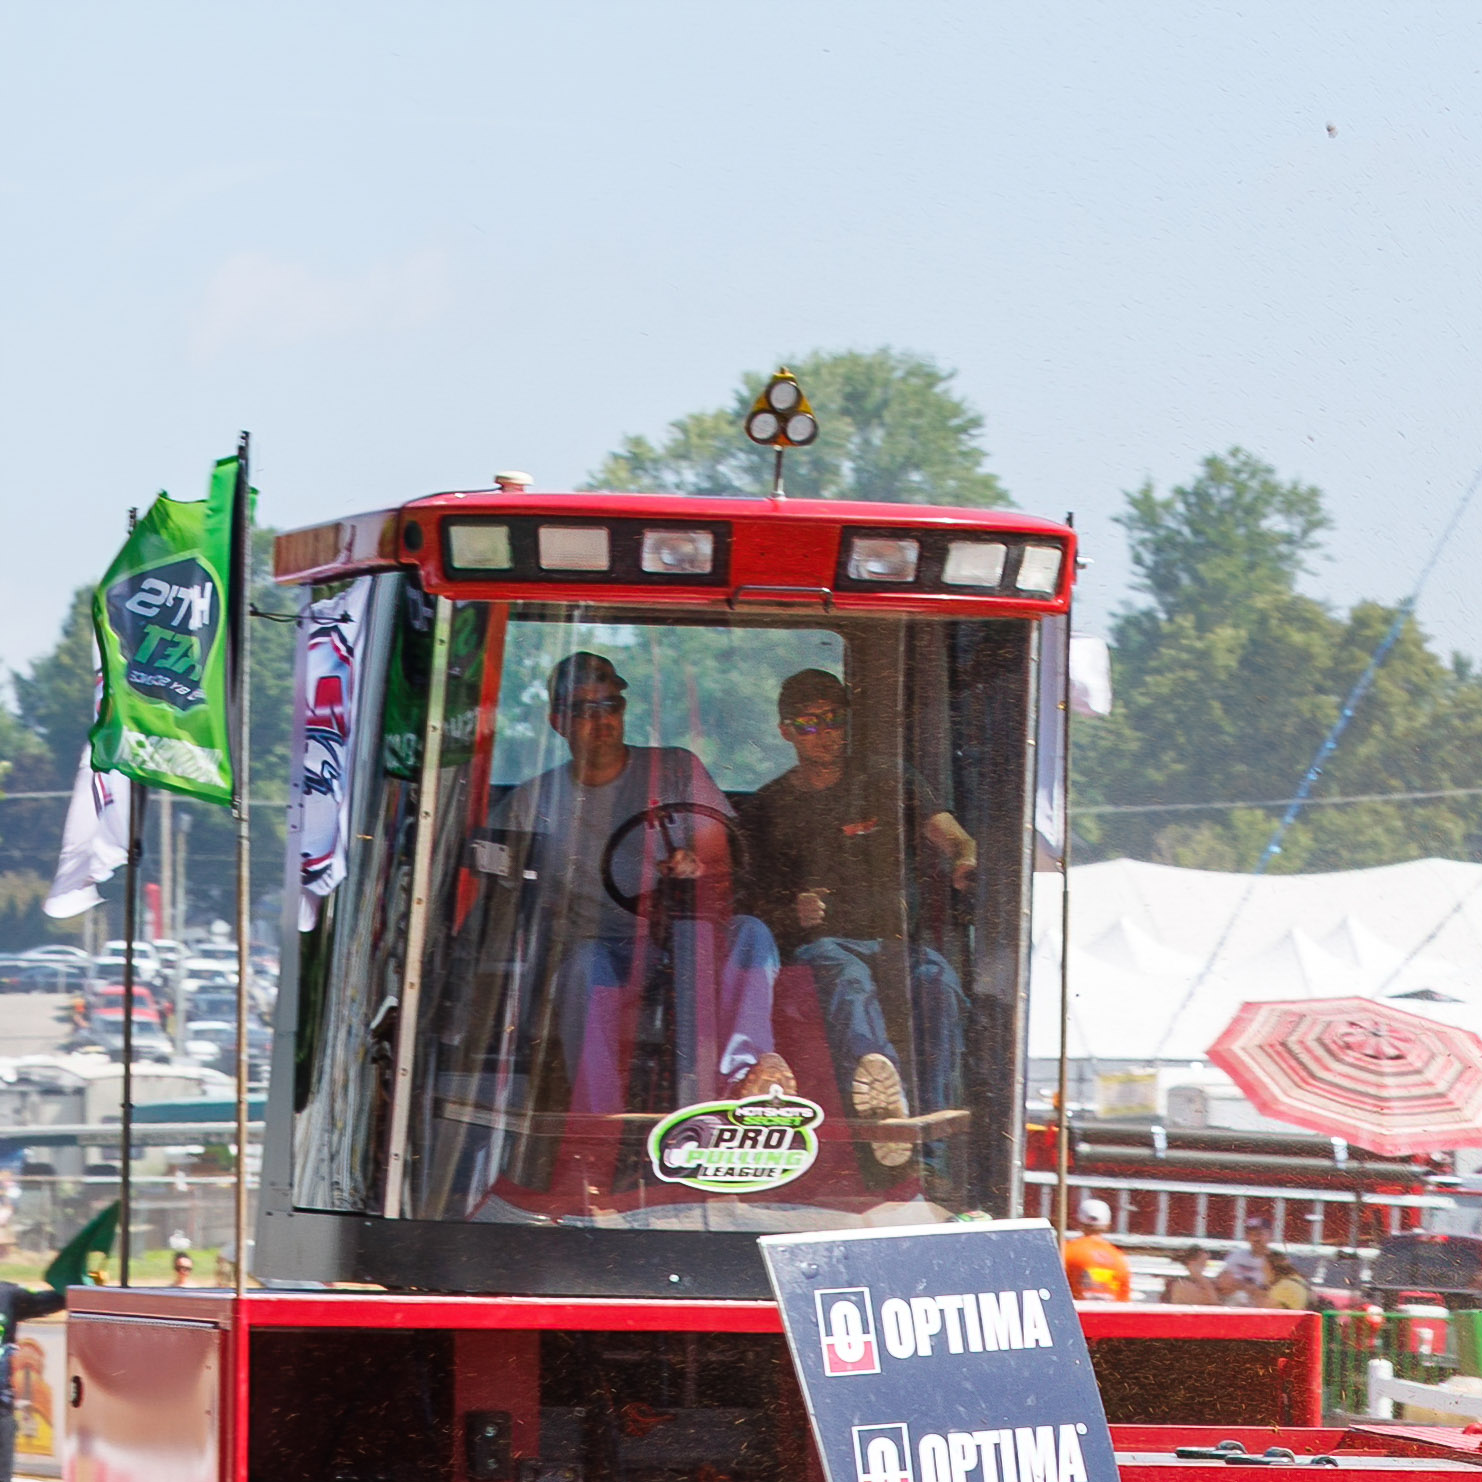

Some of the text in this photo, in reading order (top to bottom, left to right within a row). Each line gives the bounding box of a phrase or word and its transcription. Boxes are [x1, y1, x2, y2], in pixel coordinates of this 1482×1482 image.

[715, 1128, 788, 1150] PRO
[686, 1150, 803, 1167] PULLING
[702, 1166, 777, 1178] LEAGUE
[881, 1290, 1053, 1359] OPTIMA
